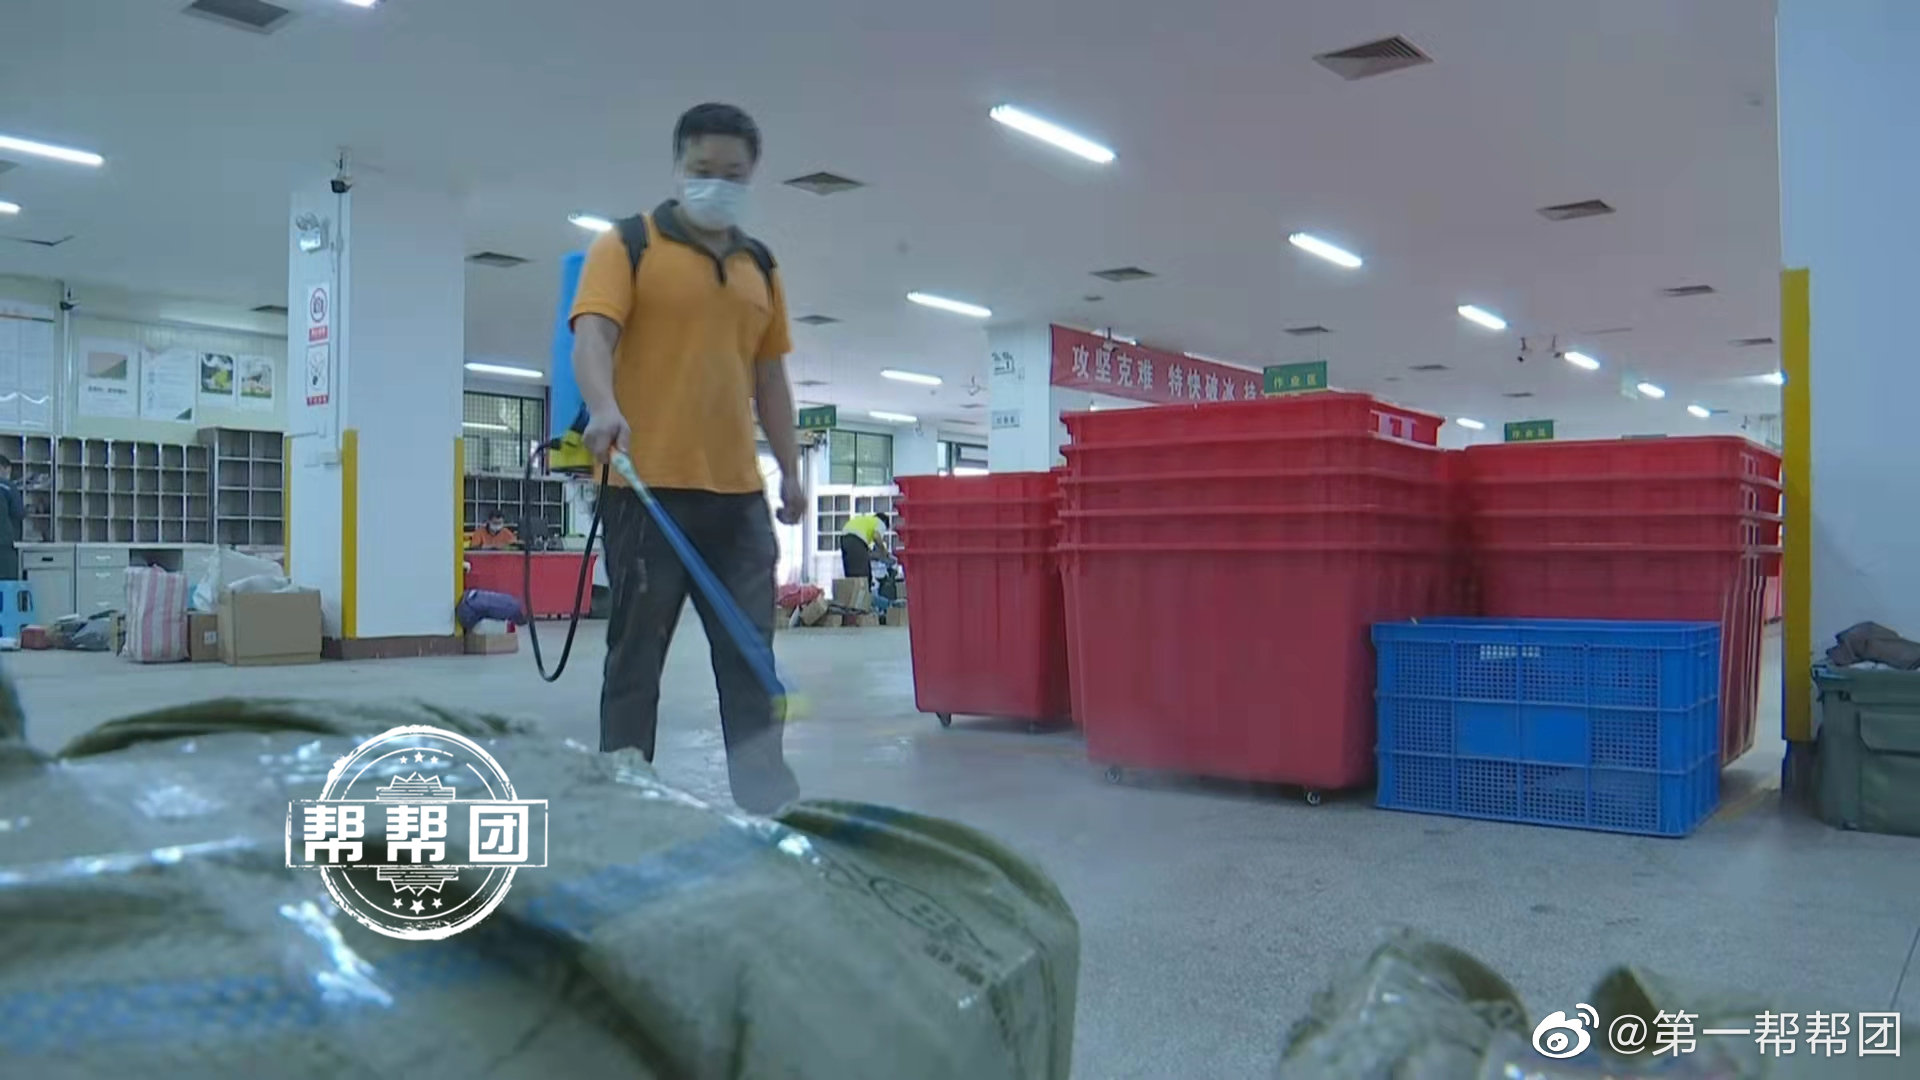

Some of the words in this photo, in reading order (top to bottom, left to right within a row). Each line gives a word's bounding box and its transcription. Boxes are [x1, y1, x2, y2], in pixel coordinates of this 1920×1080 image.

[1072, 344, 1153, 390] 攻坚克难
[1168, 363, 1236, 401] 特快破冰
